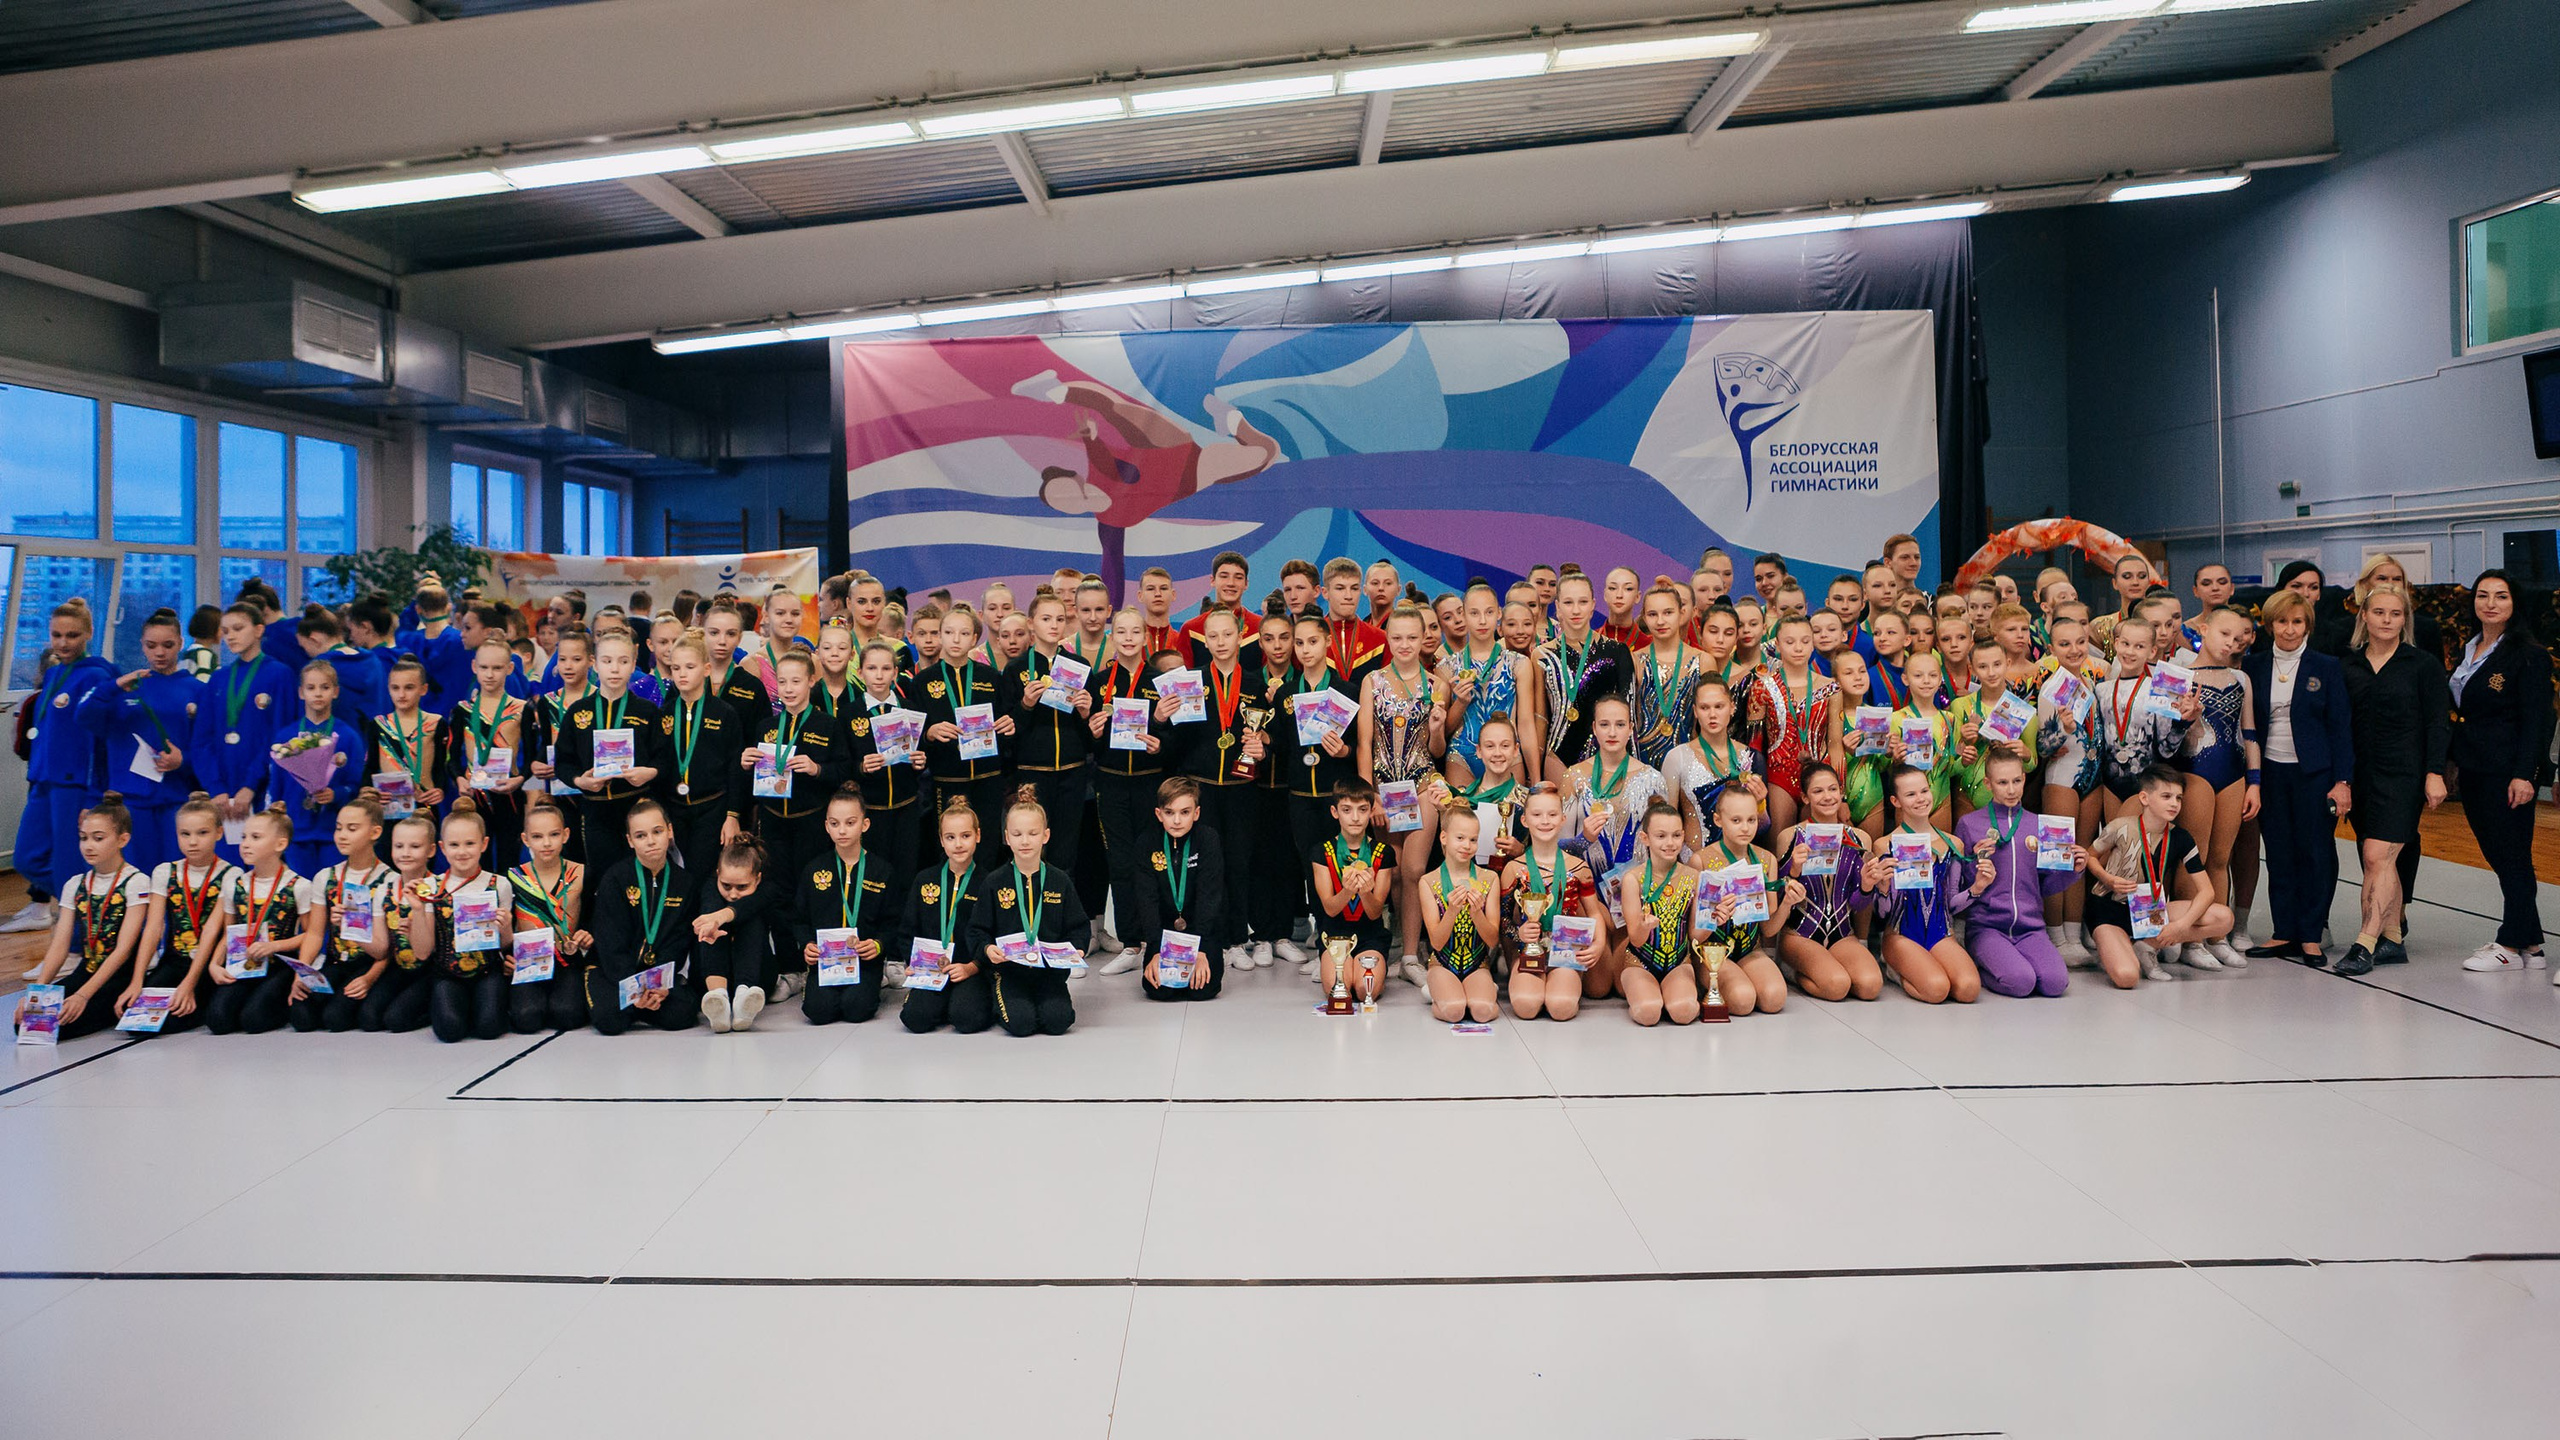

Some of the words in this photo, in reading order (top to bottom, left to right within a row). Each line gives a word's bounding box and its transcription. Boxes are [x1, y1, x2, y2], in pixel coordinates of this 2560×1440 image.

[1769, 441, 1879, 457] БЕЛОРУССКАЯ
[1769, 460, 1878, 476] АССОЦИАЦИЯ
[1771, 477, 1879, 493] ГИМНАСТИКИ
